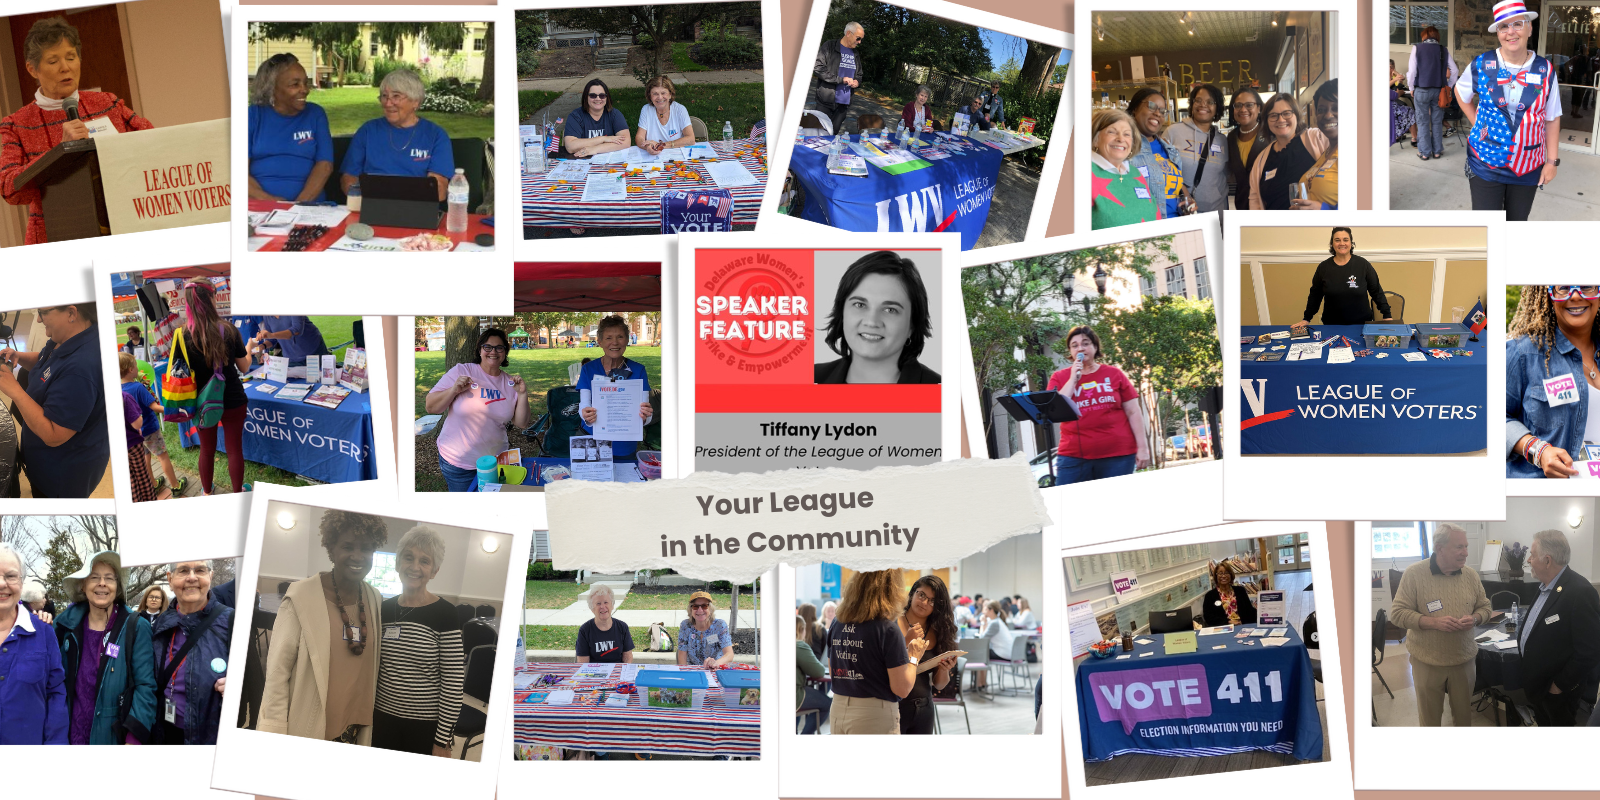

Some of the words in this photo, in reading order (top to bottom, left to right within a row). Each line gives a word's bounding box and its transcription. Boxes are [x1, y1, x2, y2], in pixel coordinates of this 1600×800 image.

[1179, 59, 1254, 86] BEER
[293, 130, 312, 141] LWV
[410, 148, 429, 159] LWV
[143, 164, 195, 192] LEAGUE
[196, 161, 213, 184] OF
[953, 177, 982, 200] LEAGUE
[982, 176, 989, 187] OF
[132, 191, 184, 221] WOMEN
[184, 183, 231, 213] VOTERS
[957, 193, 985, 217] WOMEN
[680, 212, 712, 223] Your
[703, 255, 754, 292] Delaware
[756, 252, 805, 289] Women's
[696, 295, 809, 316] SPEAKER
[699, 320, 806, 340] FEATURE
[703, 335, 726, 361] rike
[725, 354, 736, 366] &
[1074, 382, 1114, 397] VTE
[1296, 384, 1383, 400] LEAGUE
[1390, 387, 1416, 400] OF
[1548, 380, 1573, 391] VOTE
[480, 388, 501, 400] LWV
[1557, 390, 1572, 400] 411
[1076, 399, 1090, 408] IKE
[246, 407, 287, 425] AGUE
[292, 416, 314, 429] OF
[1297, 404, 1386, 419] WOMEN
[1391, 404, 1478, 420] VOTERS
[243, 420, 292, 442] OMEN
[760, 422, 821, 441] Tiffany
[825, 422, 877, 441] Lydon
[695, 445, 761, 458] President
[765, 445, 781, 458] of
[784, 445, 807, 458] the
[811, 446, 864, 461] League
[868, 445, 883, 458] of
[887, 446, 942, 458] Women
[1114, 582, 1130, 590] VOTE
[1130, 578, 1138, 586] 411
[842, 623, 857, 634] Ask
[595, 640, 615, 653] LWV
[832, 638, 842, 646] me
[842, 637, 864, 649] about
[835, 650, 858, 663] Voting
[1099, 678, 1202, 710] VOTE
[1216, 670, 1283, 704] 411
[1139, 725, 1179, 738] ELECTION
[1181, 722, 1239, 735] INFORMATION
[1241, 721, 1259, 732] YOU
[1261, 720, 1284, 733] NEED
